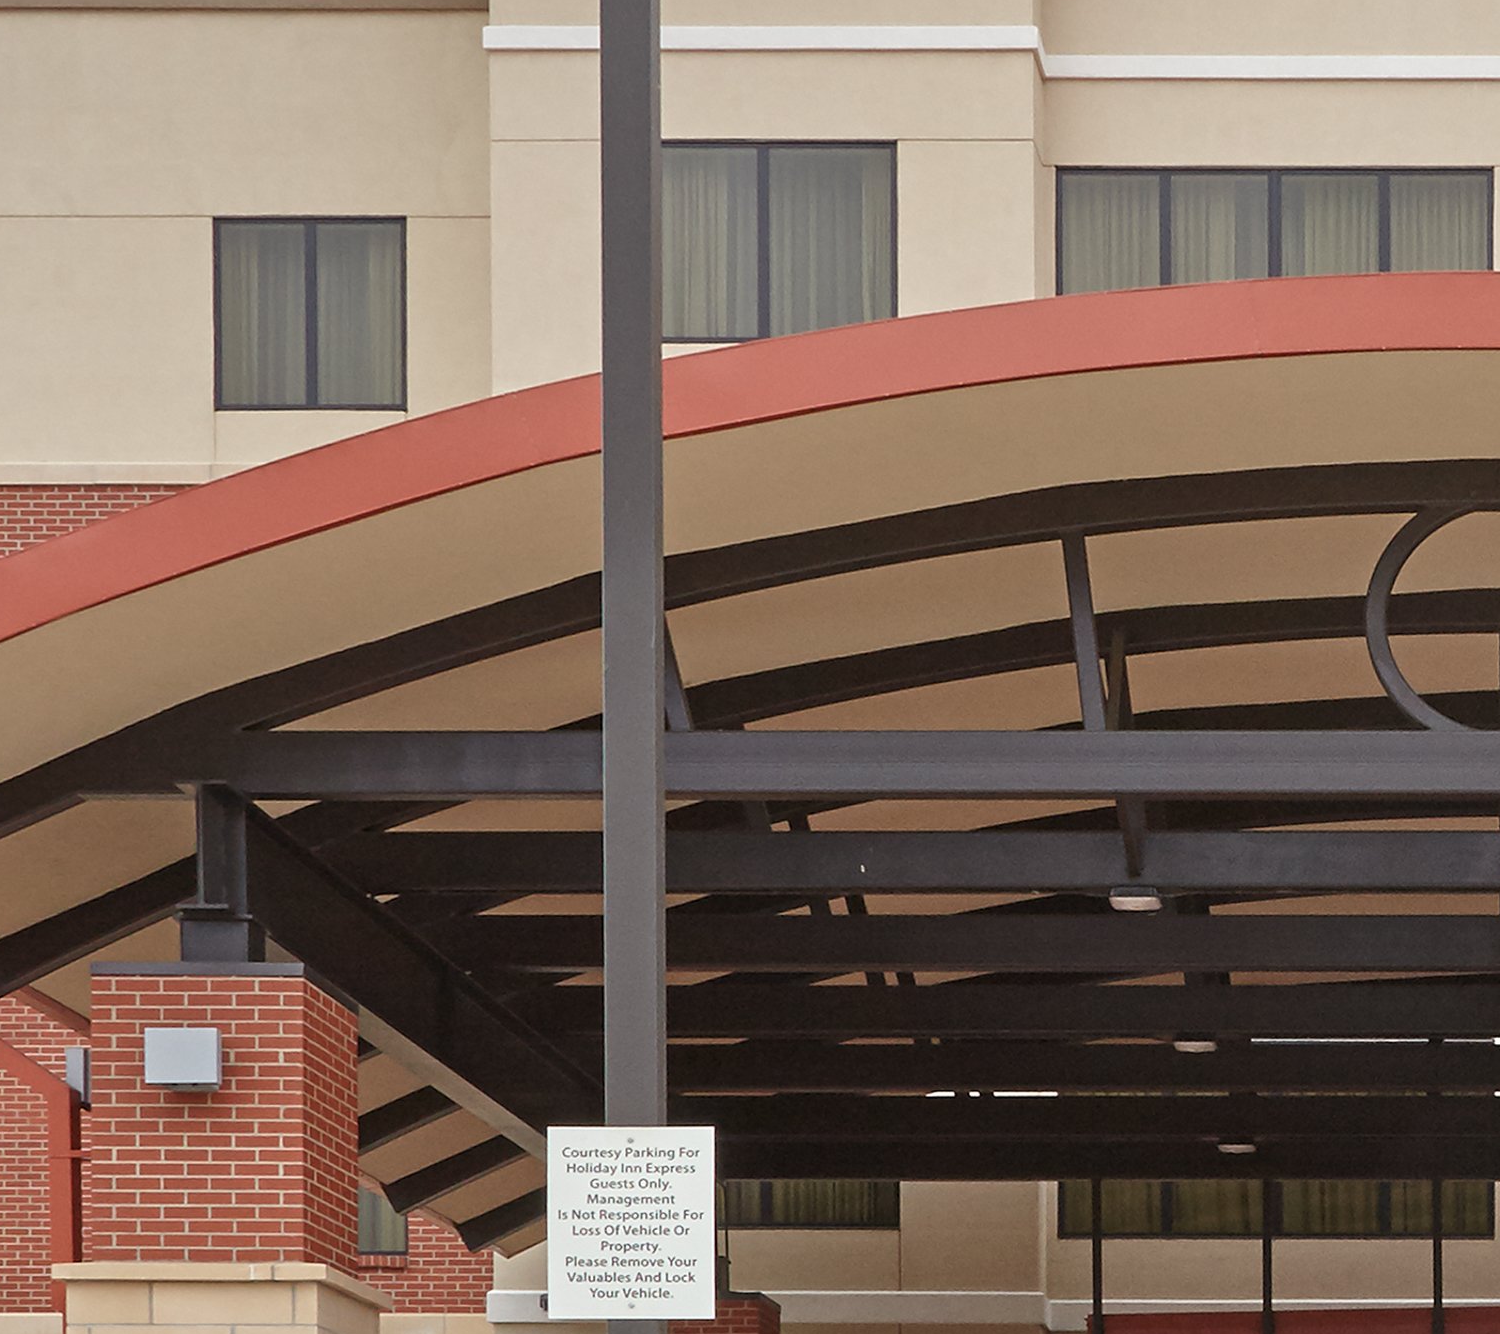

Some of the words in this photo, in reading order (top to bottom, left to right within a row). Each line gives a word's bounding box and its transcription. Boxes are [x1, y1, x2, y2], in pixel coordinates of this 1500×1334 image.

[562, 1147, 622, 1160] Courtesy
[625, 1147, 675, 1160] Parking
[679, 1147, 700, 1158] For
[567, 1163, 617, 1176] Holiday
[621, 1163, 642, 1174] Inn
[646, 1163, 696, 1176] Express
[590, 1178, 635, 1189] Guests
[638, 1178, 672, 1191] Only.
[587, 1194, 675, 1207] Management
[558, 1210, 568, 1220] Is
[572, 1209, 595, 1220] Not
[599, 1209, 679, 1222] Responsible
[683, 1209, 704, 1220] For
[572, 1225, 601, 1236] Loss
[604, 1224, 620, 1236] Of
[623, 1225, 670, 1236] Vehicle
[674, 1225, 690, 1236] Or
[601, 1241, 661, 1254] Property.
[565, 1256, 608, 1267] Please
[611, 1256, 664, 1267] Remove
[668, 1256, 697, 1267] Your
[567, 1272, 631, 1283] Valuables
[635, 1272, 661, 1283] And
[665, 1272, 695, 1283] Lock
[590, 1288, 620, 1298] Your
[622, 1288, 673, 1298] Vehicle.
